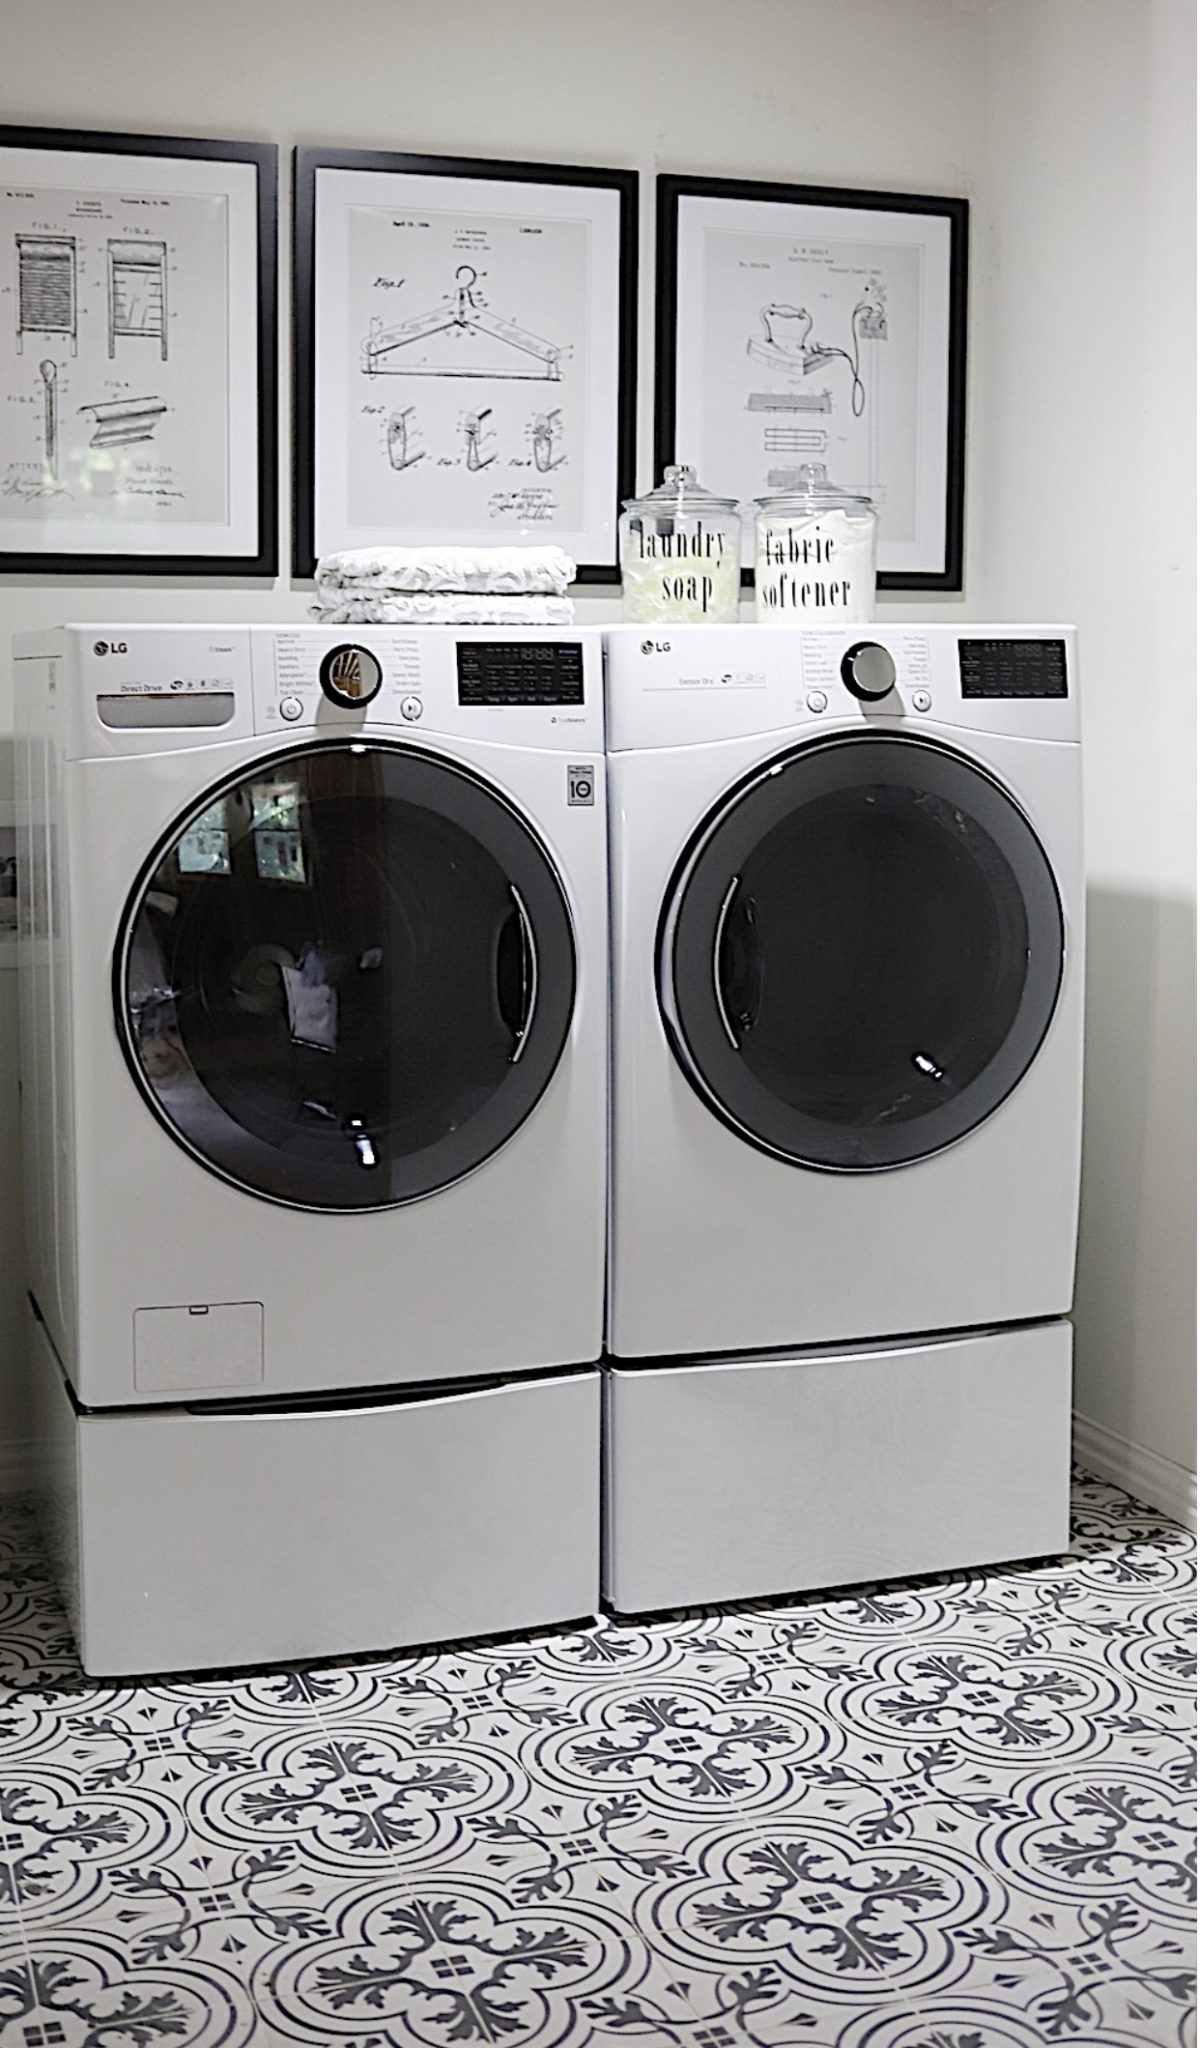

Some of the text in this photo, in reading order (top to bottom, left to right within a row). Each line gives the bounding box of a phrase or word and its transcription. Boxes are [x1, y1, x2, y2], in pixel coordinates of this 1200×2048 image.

[638, 520, 726, 569] laundry
[765, 525, 834, 566] fabric
[661, 574, 713, 613] soap
[762, 572, 851, 609] softener
[111, 642, 128, 653] LG
[655, 641, 671, 652] LG
[570, 780, 592, 799] 10
